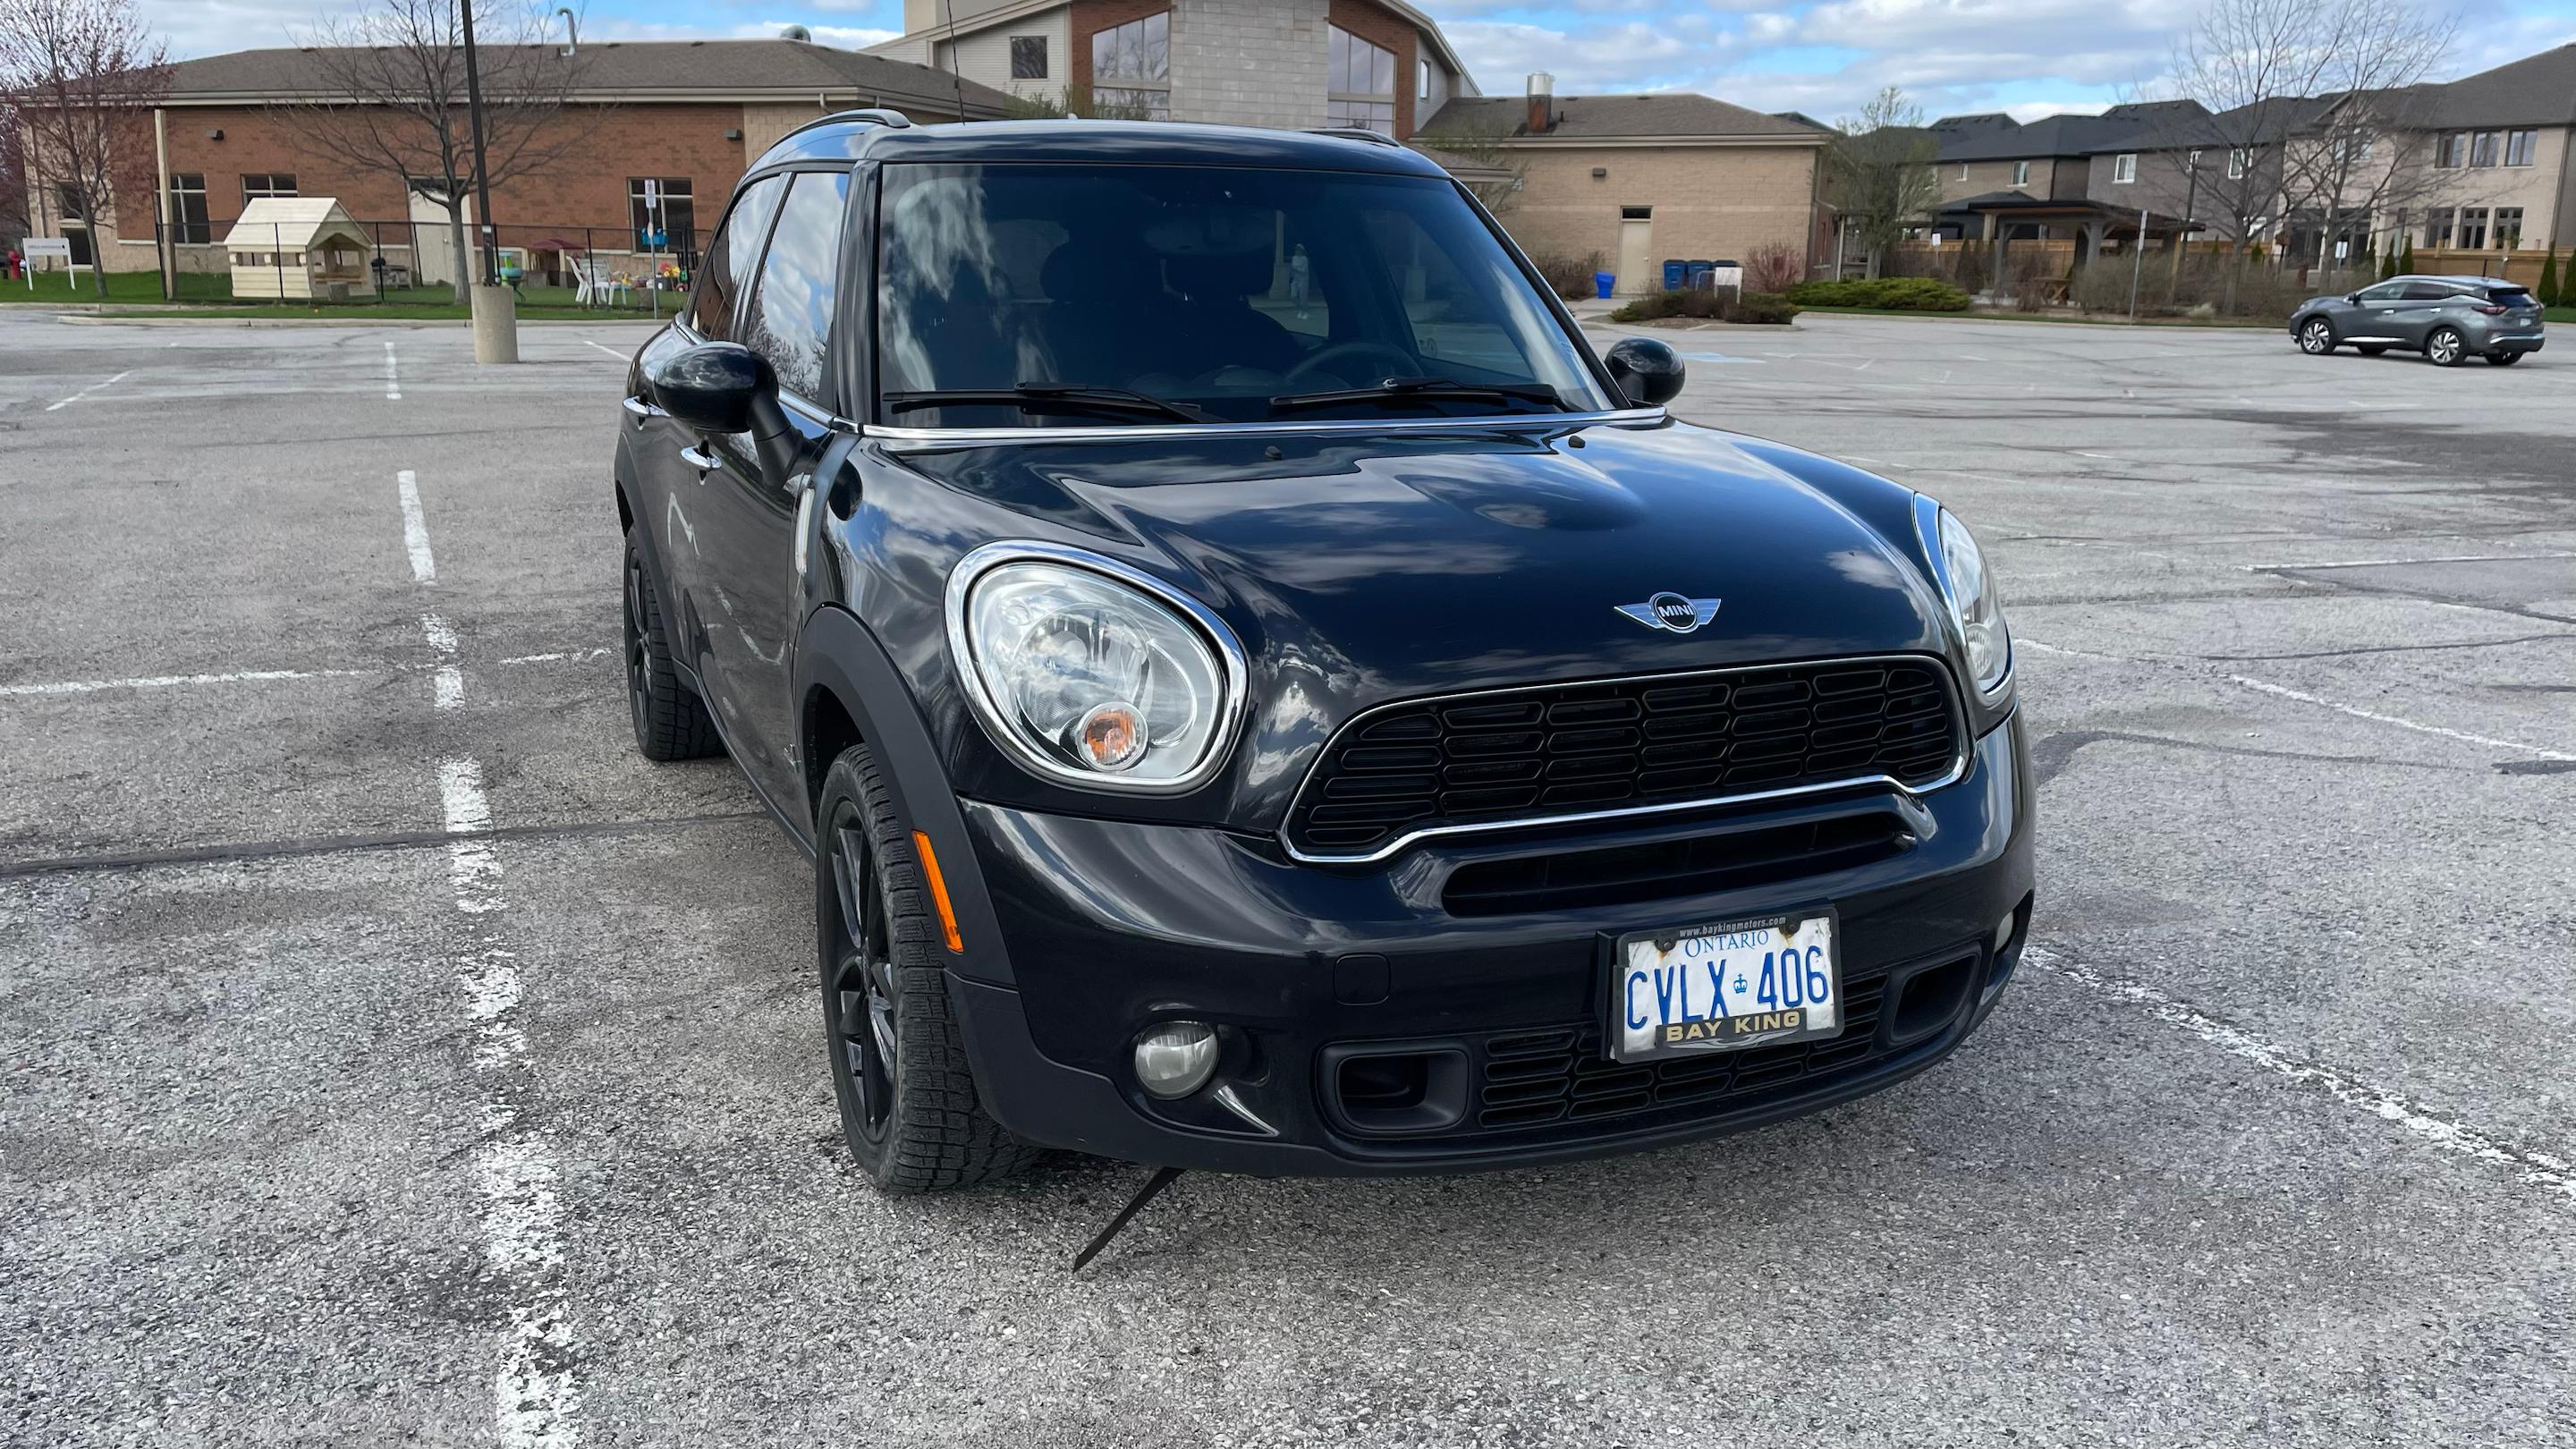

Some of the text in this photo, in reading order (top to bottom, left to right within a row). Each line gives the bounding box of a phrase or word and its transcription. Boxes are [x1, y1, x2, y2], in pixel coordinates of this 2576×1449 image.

[1657, 605, 1694, 618] MINI
[1679, 916, 1786, 937] www.baykingmotors.com
[1684, 929, 1769, 958] ONTARIO
[1627, 945, 1829, 1030] CVLX 406
[1666, 1011, 1801, 1042] BAY KING
